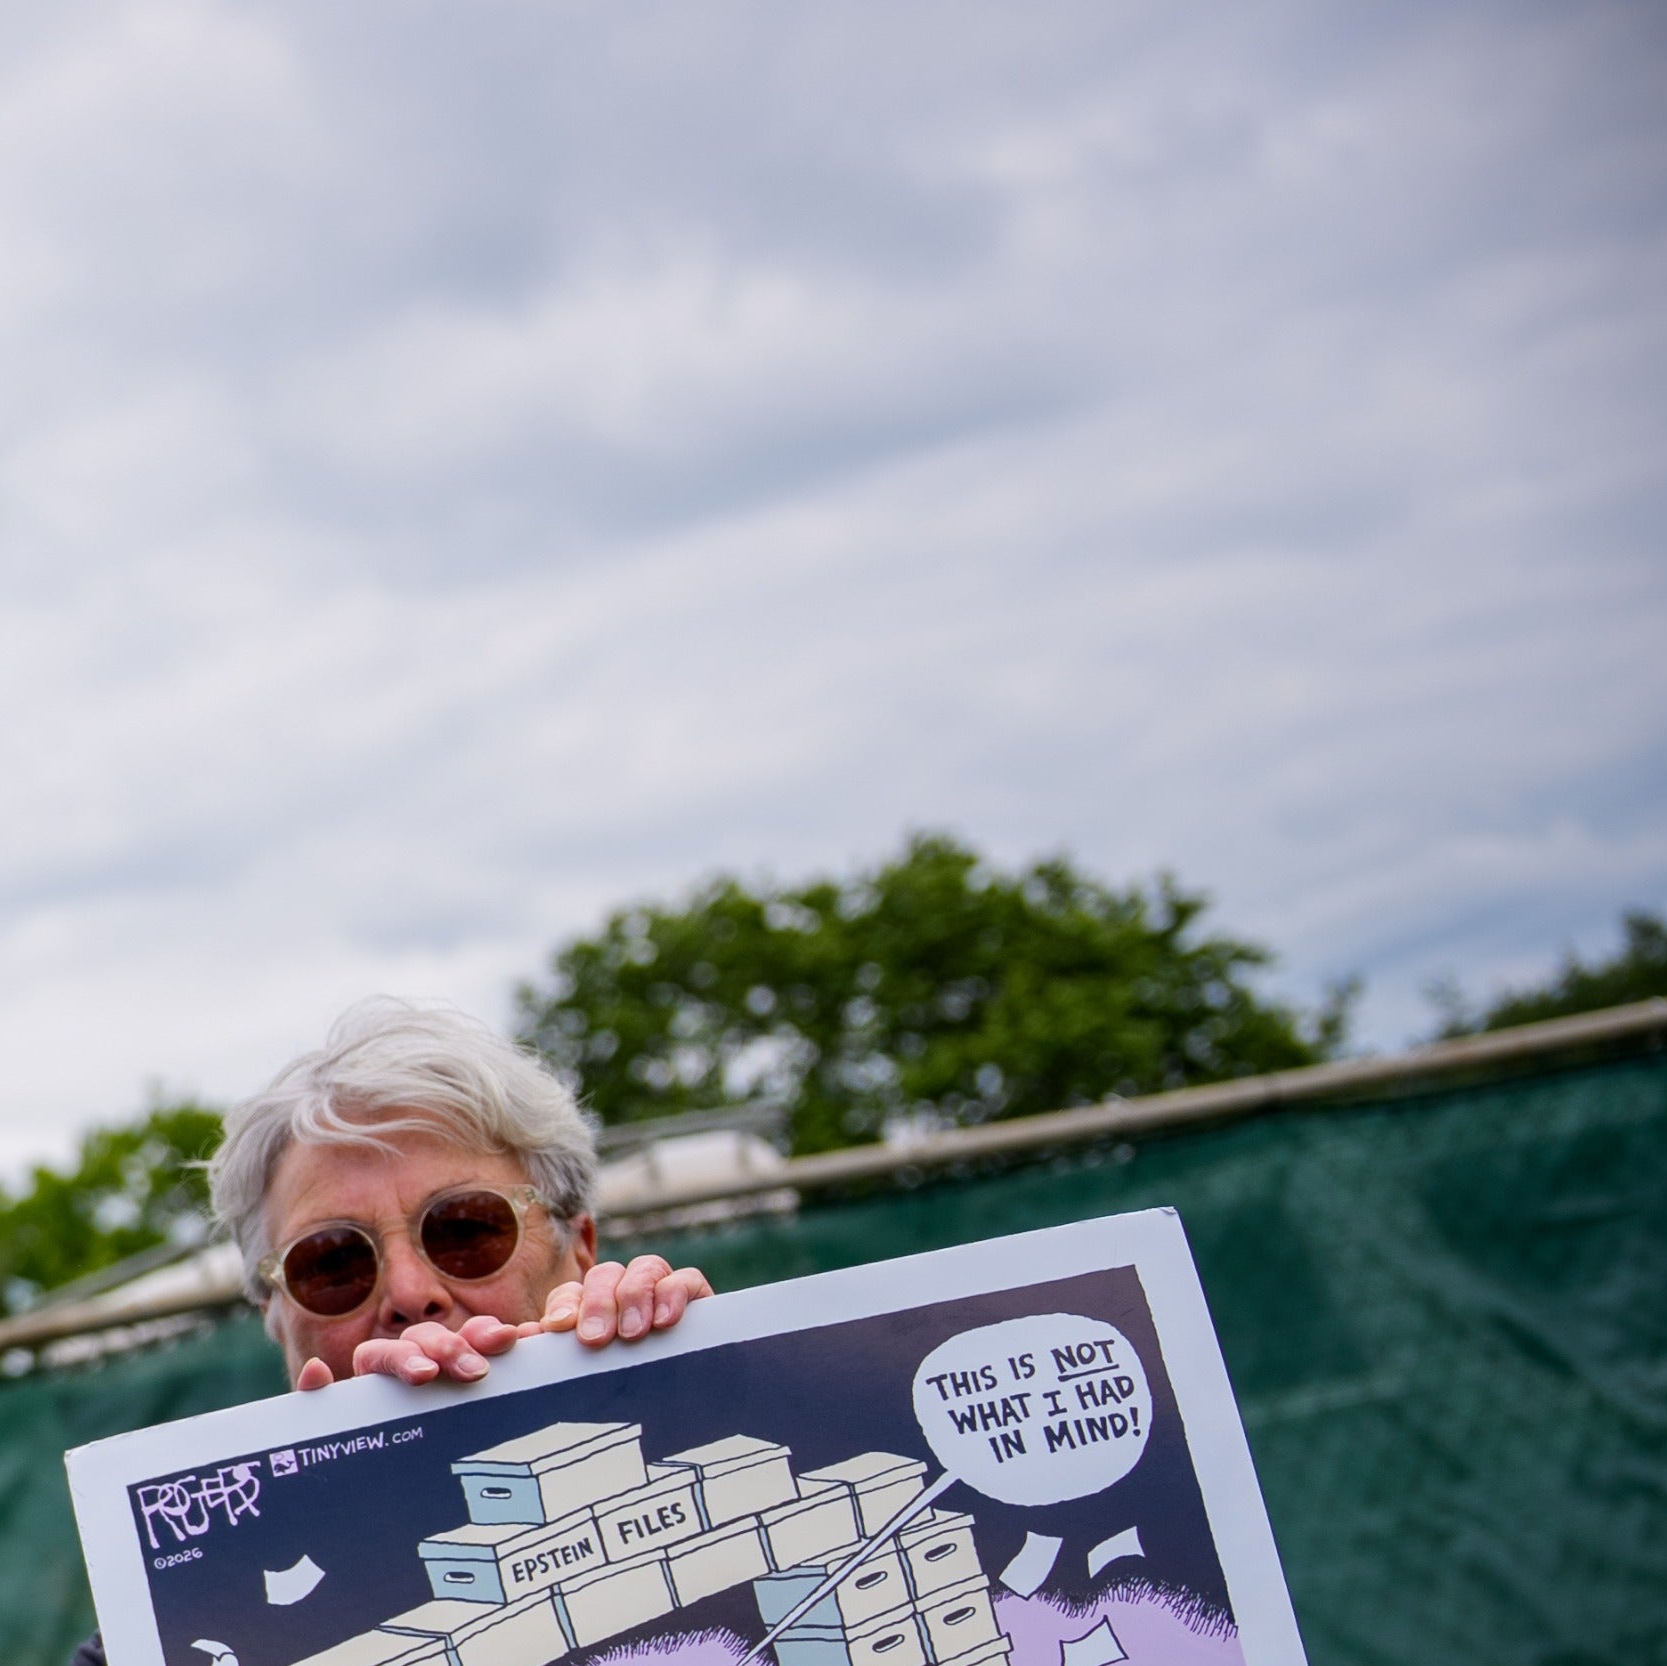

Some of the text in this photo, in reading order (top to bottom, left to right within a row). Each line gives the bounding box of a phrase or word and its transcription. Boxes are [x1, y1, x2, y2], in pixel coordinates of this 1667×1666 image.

[925, 1339, 1115, 1401] THIS IS NOT
[947, 1375, 1135, 1434] WHAT I HAD
[988, 1406, 1142, 1463] IN MIND!
[511, 1502, 686, 1583] EPSTEIN FILES
